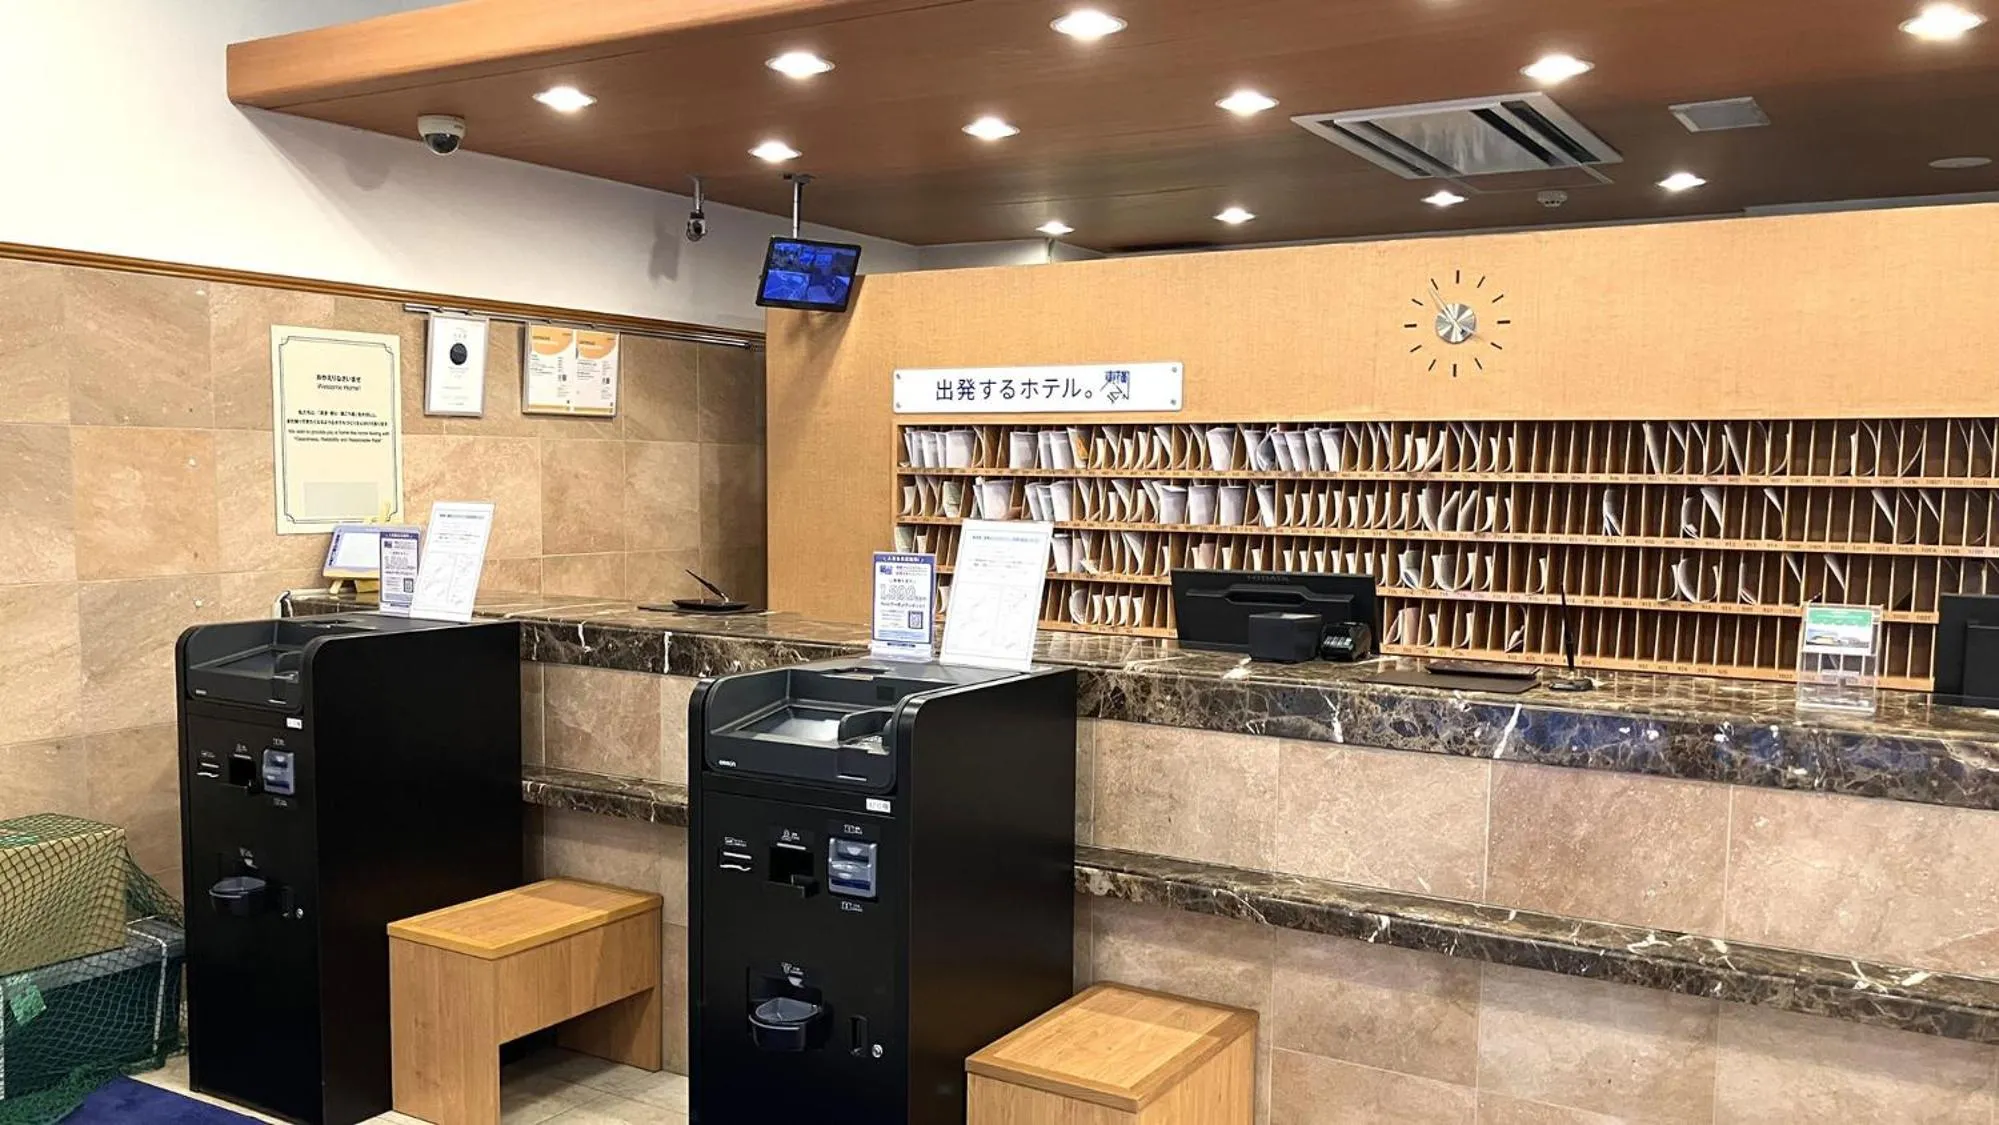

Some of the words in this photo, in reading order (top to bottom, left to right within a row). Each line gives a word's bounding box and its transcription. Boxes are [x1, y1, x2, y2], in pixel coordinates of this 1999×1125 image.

[936, 378, 1093, 401] 出発するホテル。
